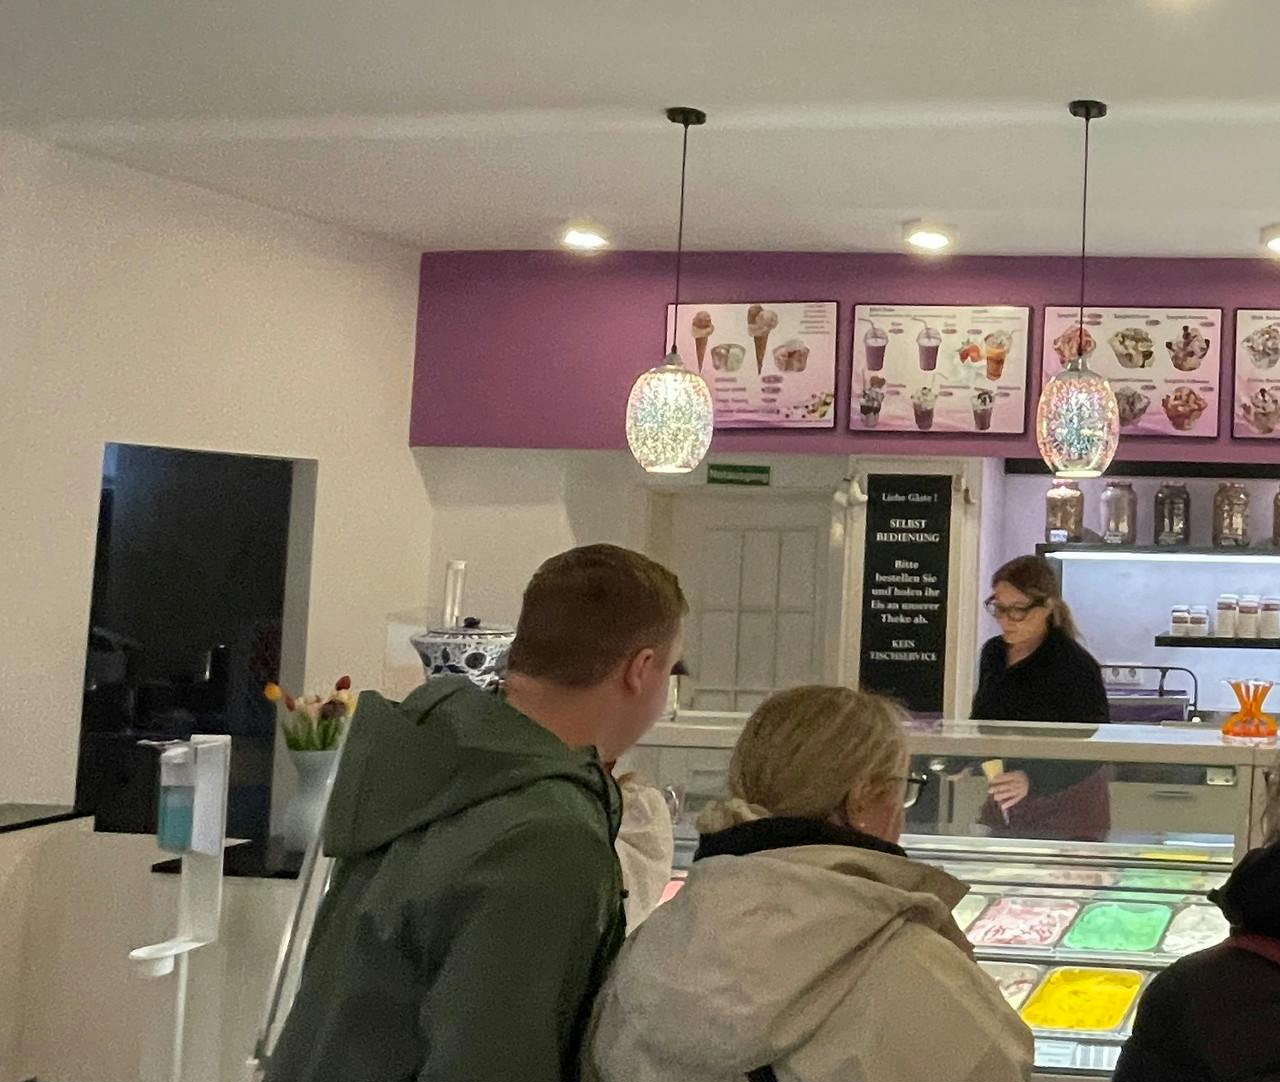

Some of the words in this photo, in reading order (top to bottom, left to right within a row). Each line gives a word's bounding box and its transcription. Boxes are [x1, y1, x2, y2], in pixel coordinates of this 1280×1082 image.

[889, 518, 928, 529] SELBST
[876, 532, 940, 543] BEDIENUNG
[894, 559, 920, 570] Bitte
[875, 572, 920, 583] bestellen
[921, 573, 938, 583] Sie
[871, 586, 893, 596] und
[893, 586, 922, 597] holen
[871, 599, 885, 609] Eis
[901, 602, 940, 610] unserer
[880, 613, 912, 623] Theke
[891, 639, 916, 648] KEIN
[870, 651, 937, 661] TISCHSERVICE
